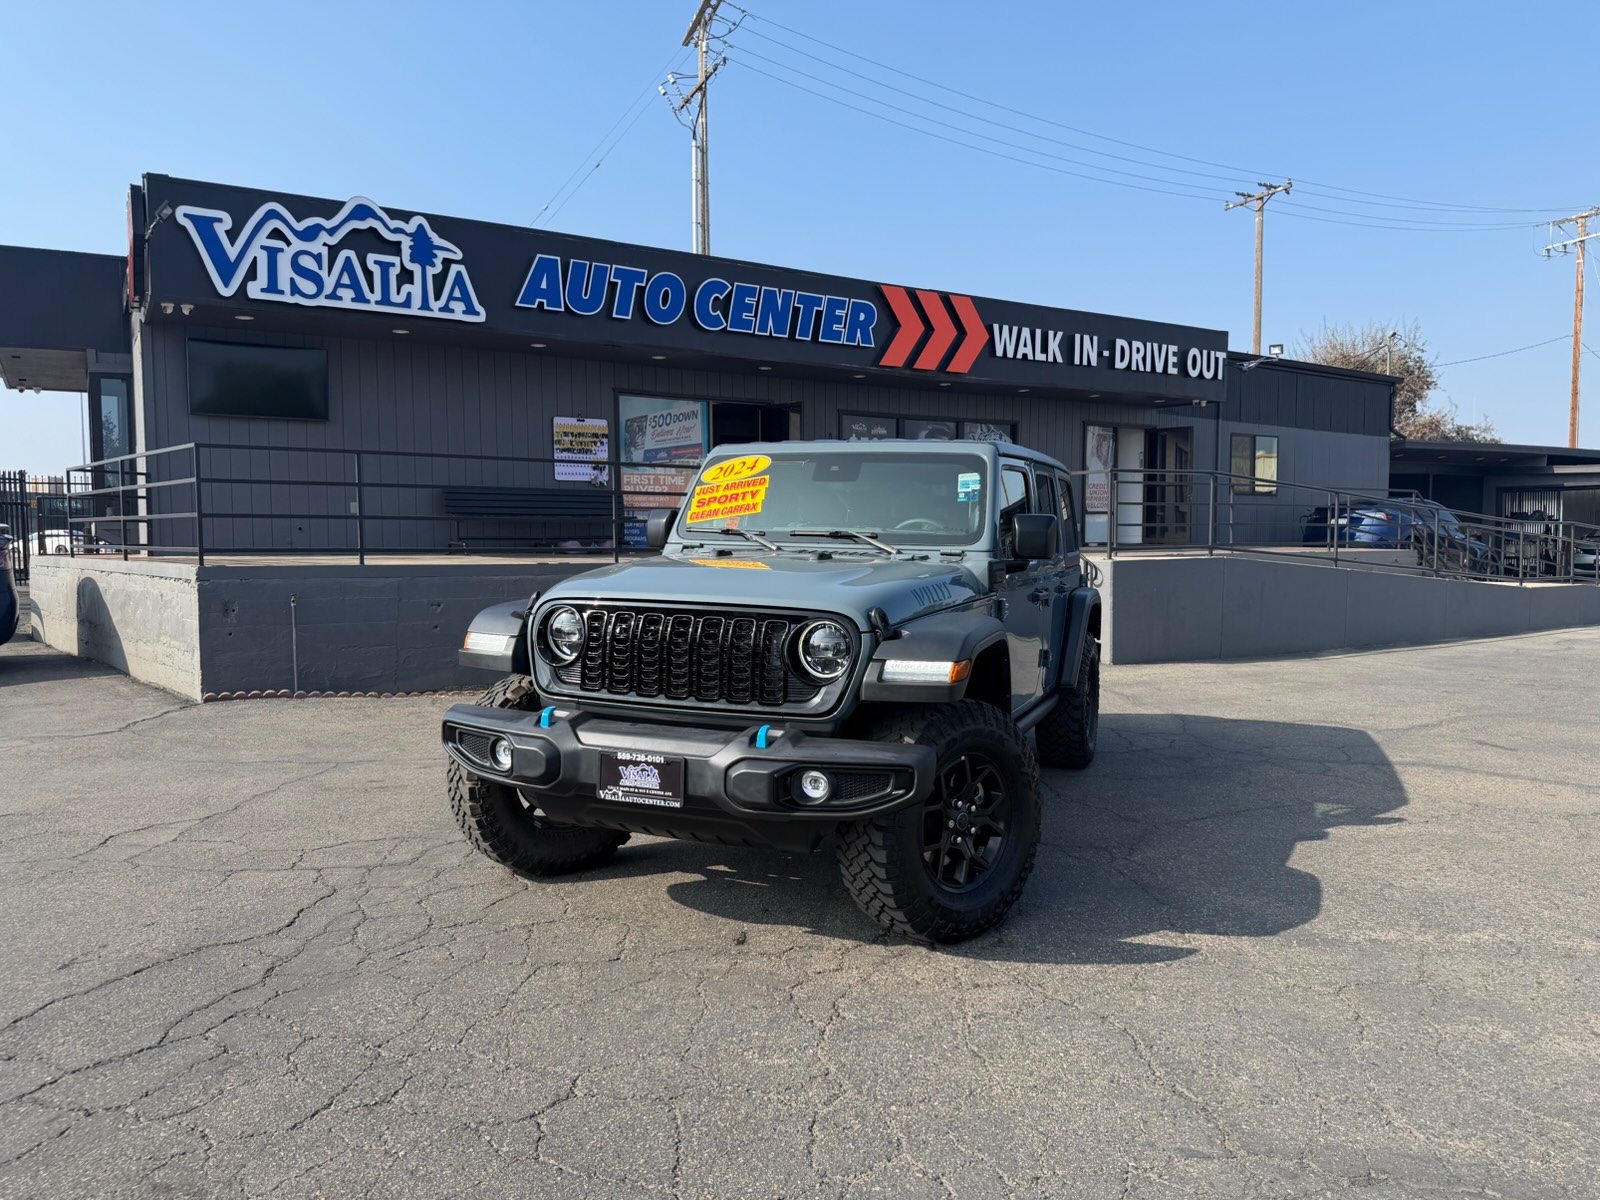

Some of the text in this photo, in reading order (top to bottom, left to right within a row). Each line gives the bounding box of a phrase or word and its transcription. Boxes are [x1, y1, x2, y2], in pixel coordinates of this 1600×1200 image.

[175, 200, 486, 321] VISALIA
[515, 253, 878, 348] AUTO CENTER
[993, 323, 1063, 364] WALK
[1074, 333, 1098, 367] IN
[1114, 338, 1178, 375] DRIVE
[1186, 347, 1227, 381] OUT
[648, 409, 699, 429] $500 DOWN
[623, 474, 685, 486] FIRST TIME
[711, 457, 760, 481] 2024
[696, 477, 767, 496] JUST ARRIVED
[696, 489, 761, 508] SPORTY
[689, 502, 760, 521] CLEAN CARFAX
[910, 581, 952, 607] WILLYS
